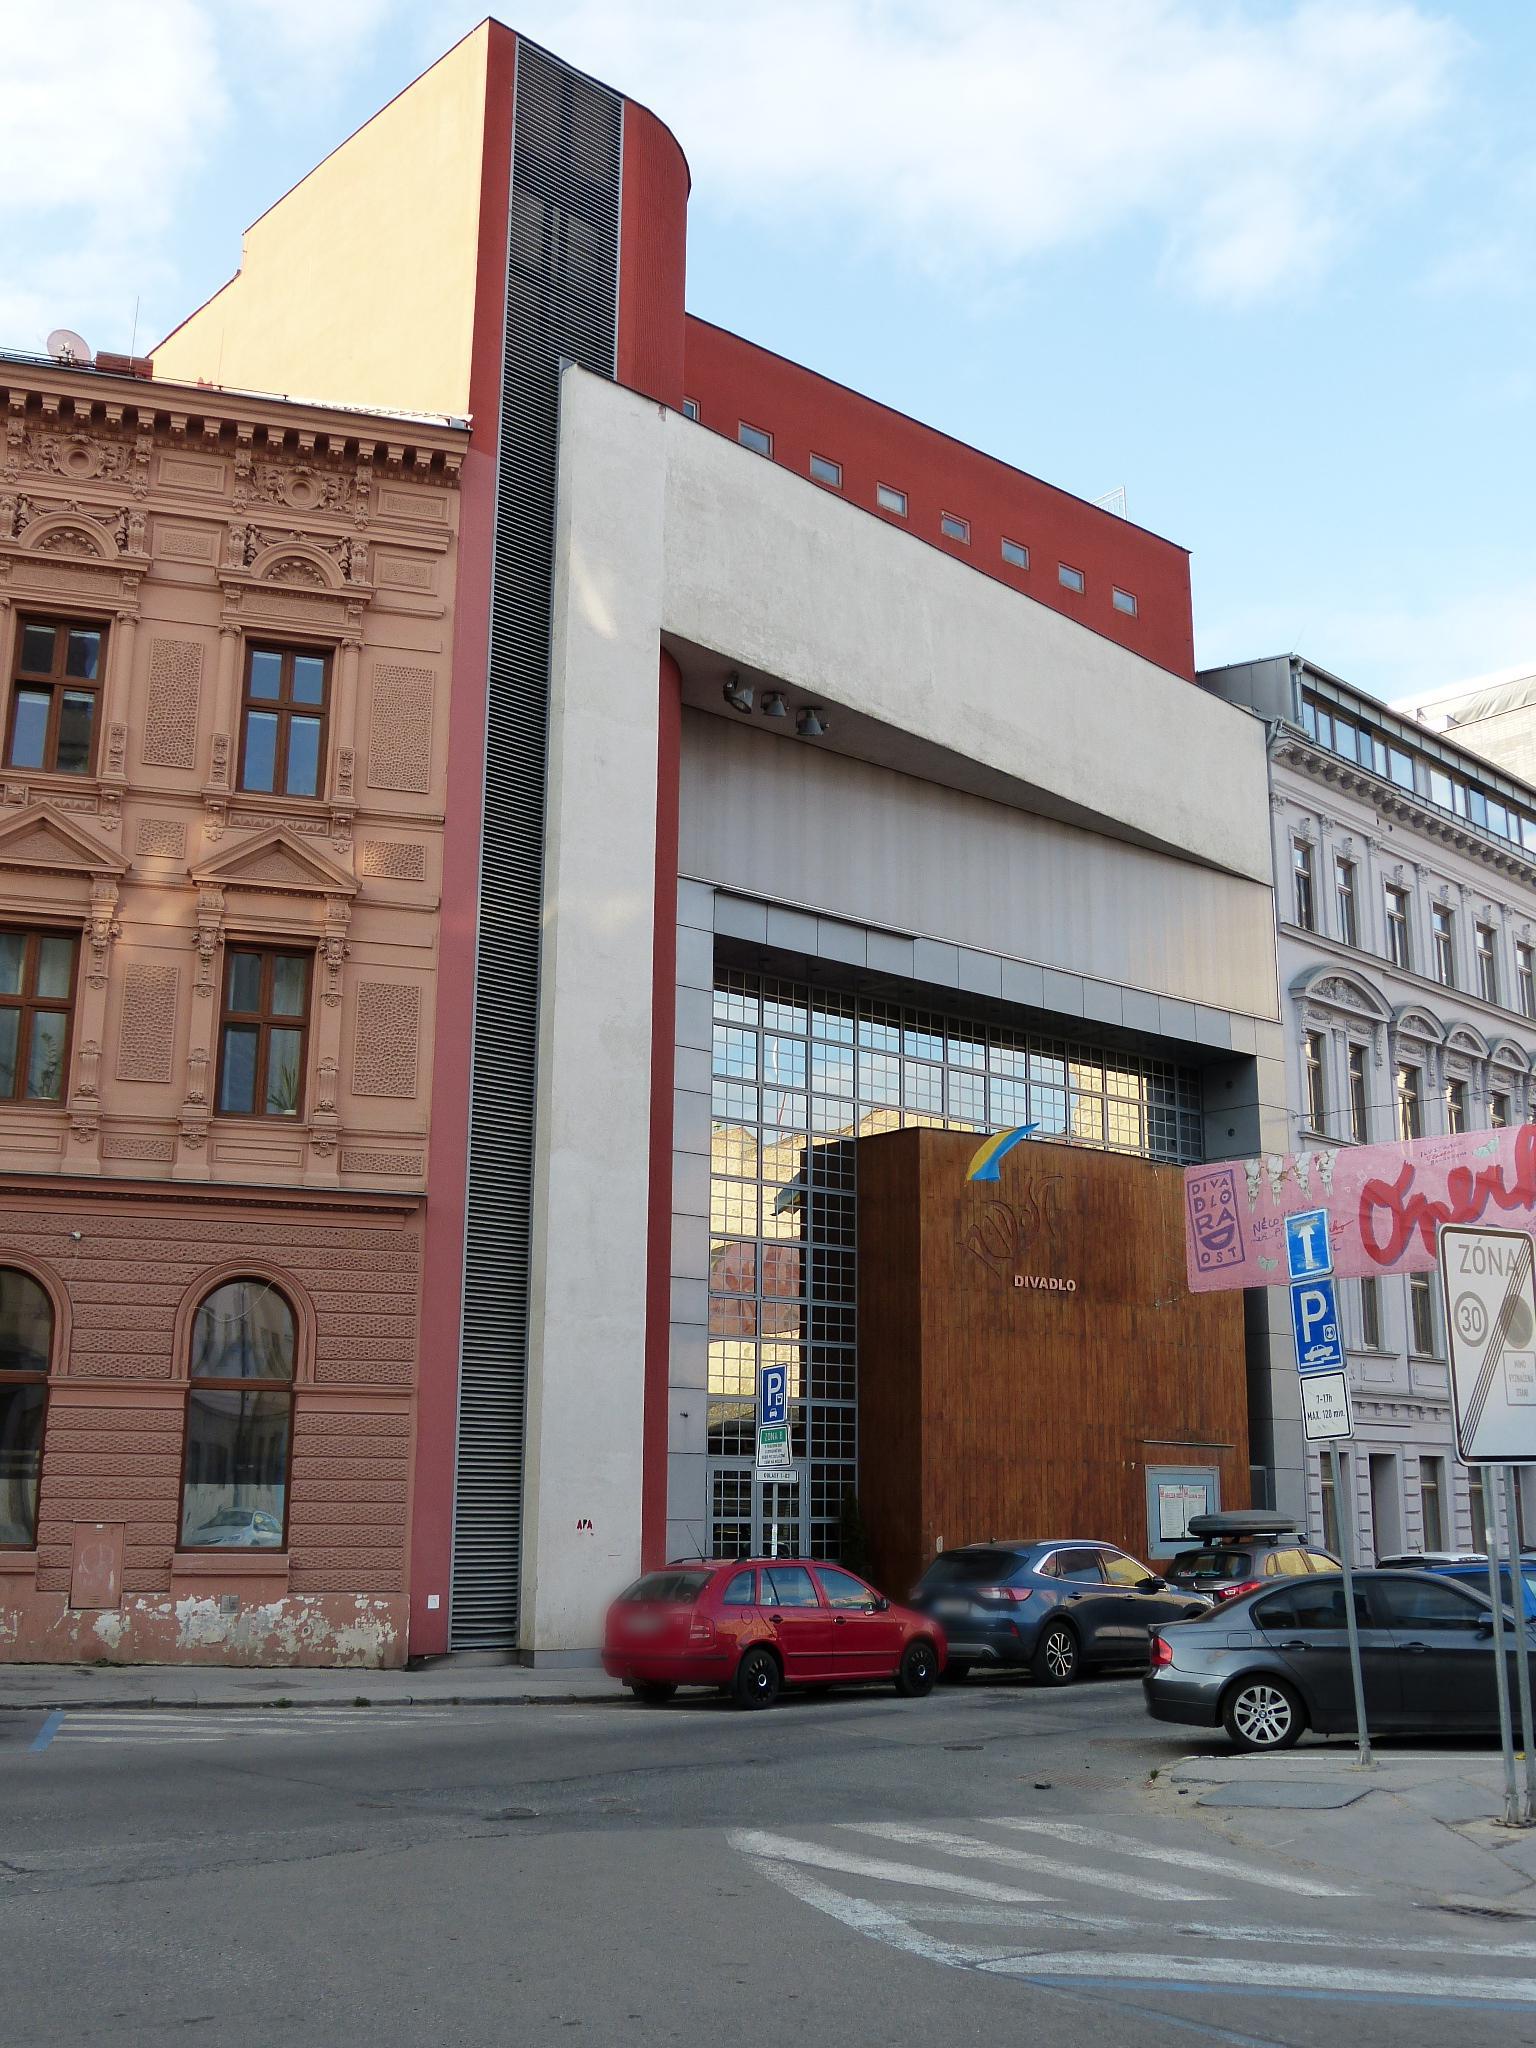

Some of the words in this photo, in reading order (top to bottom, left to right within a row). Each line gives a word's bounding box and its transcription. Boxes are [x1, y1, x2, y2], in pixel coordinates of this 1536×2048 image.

[1458, 1238, 1521, 1277] ZÓNA
[1014, 1274, 1077, 1292] DIVADLO
[1300, 1290, 1327, 1343] P
[1460, 1305, 1483, 1333] 30
[767, 1372, 782, 1407] P
